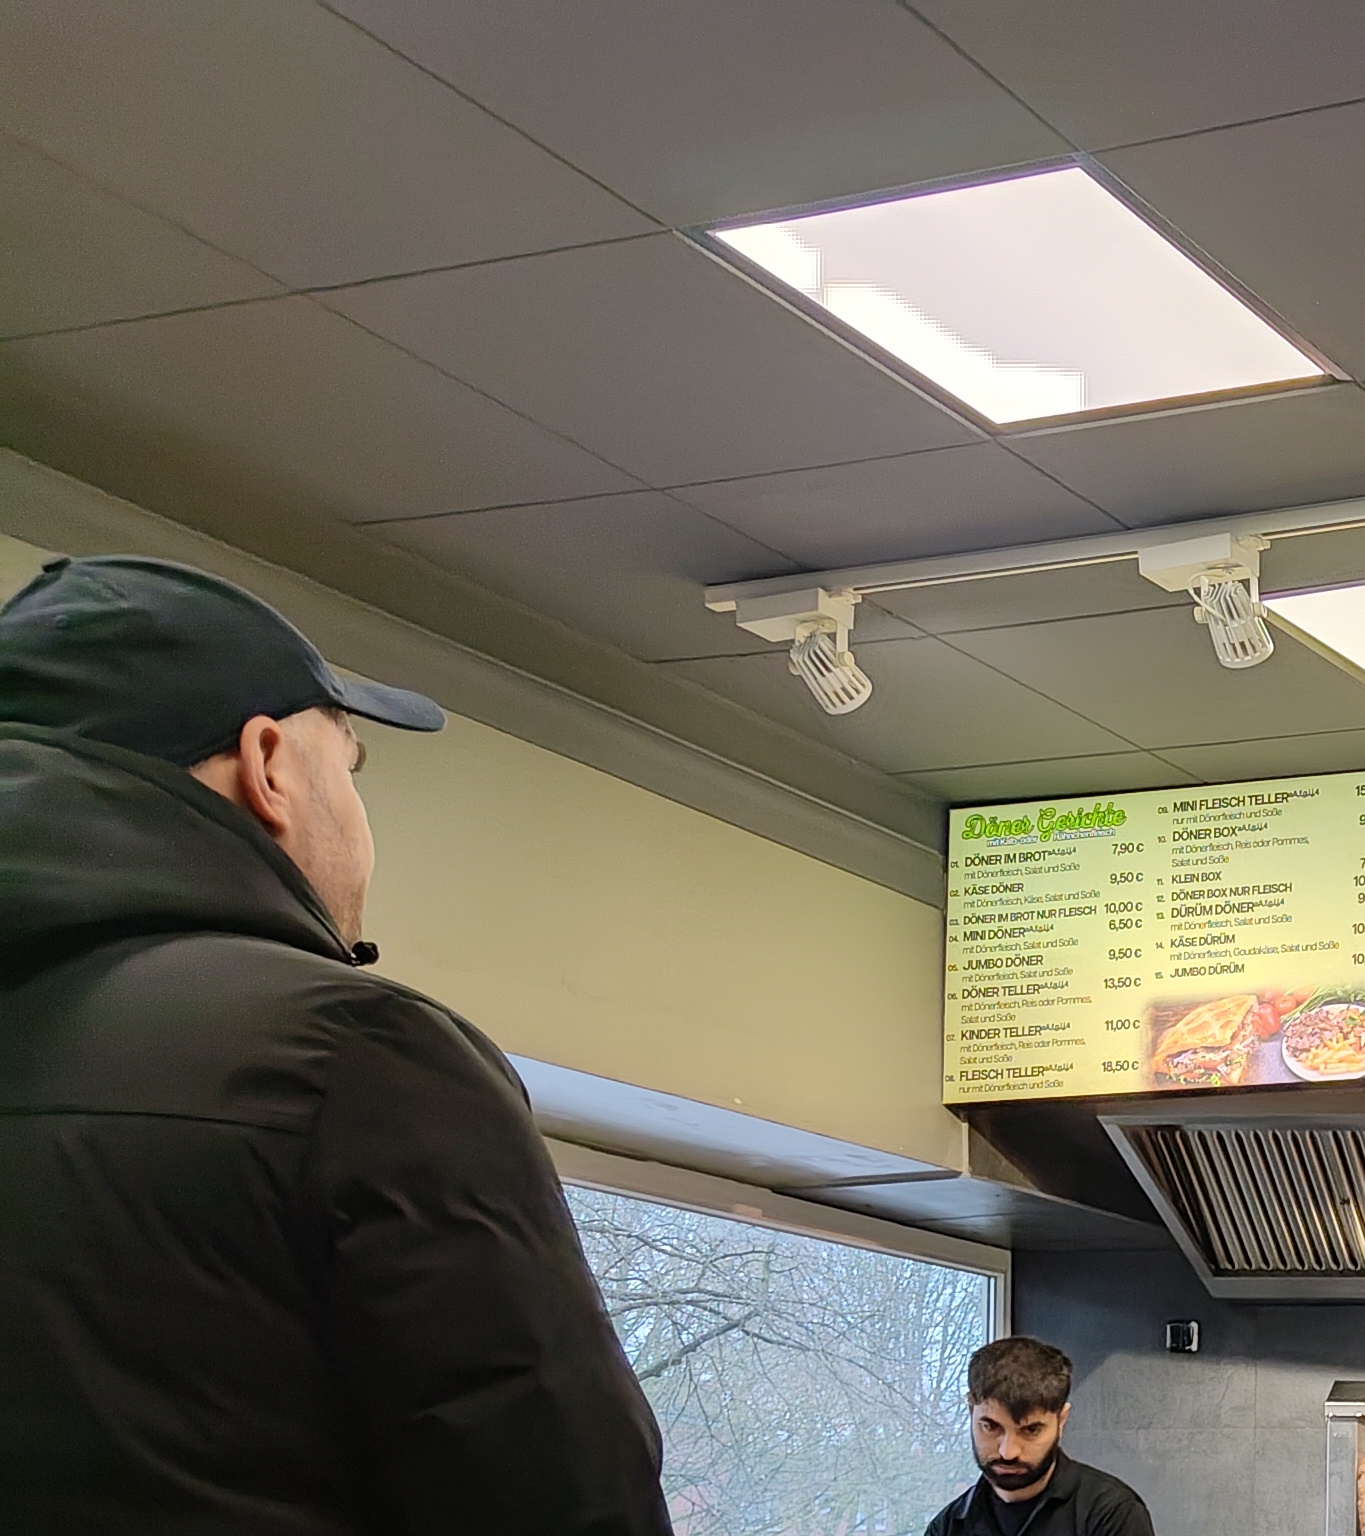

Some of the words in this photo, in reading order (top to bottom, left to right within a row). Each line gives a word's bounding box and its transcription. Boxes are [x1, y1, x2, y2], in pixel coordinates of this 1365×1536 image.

[962, 813, 1035, 839] Döner
[1037, 803, 1127, 841] Gerichte
[1172, 873, 1199, 884] KLEIN
[1201, 871, 1222, 882] BOX
[964, 884, 990, 896] KÄSE
[991, 882, 1024, 894] DÖNER
[1172, 889, 1205, 901] DÖNER
[1207, 888, 1228, 898] BOX
[1230, 886, 1250, 897] NUR
[1252, 882, 1292, 895] FLEISCH
[964, 913, 996, 925] DÖNER
[998, 913, 1008, 922] IM
[1010, 911, 1035, 922] BROT
[1037, 909, 1057, 919] NUR
[1058, 905, 1096, 918] FLEISCH
[1170, 935, 1197, 948] KÄSE
[1199, 932, 1235, 946] DÜRÜM
[963, 958, 1003, 971] JUMBO
[1006, 954, 1043, 968] DÖNER
[1170, 966, 1206, 978] JUMBO
[1208, 962, 1244, 975] DÜRÜM
